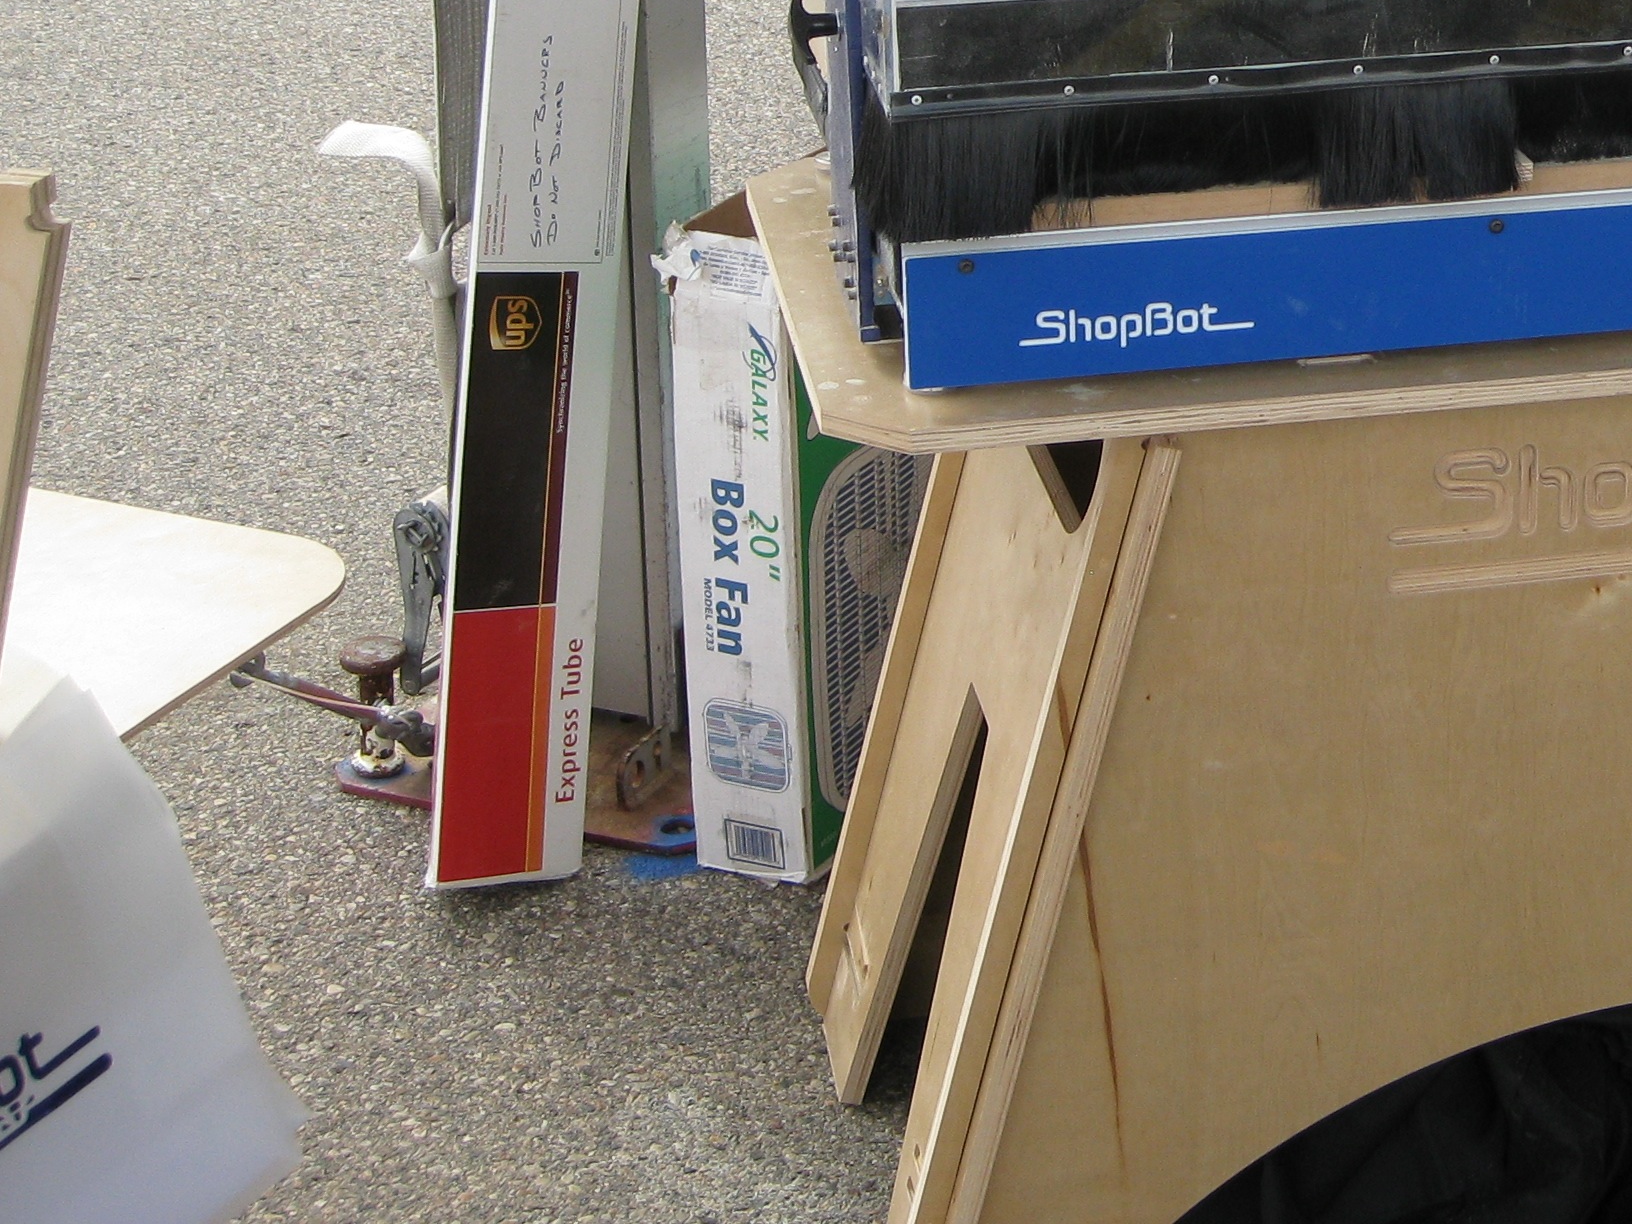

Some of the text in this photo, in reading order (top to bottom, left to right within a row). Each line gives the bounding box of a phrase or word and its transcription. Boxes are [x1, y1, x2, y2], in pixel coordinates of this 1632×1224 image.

[505, 298, 535, 346] ups
[1018, 301, 1256, 348] ShopBot
[749, 348, 769, 442] GALAXY
[703, 577, 714, 621] MODEL
[711, 478, 749, 657] Box Fan
[555, 637, 583, 804] Express Tube
